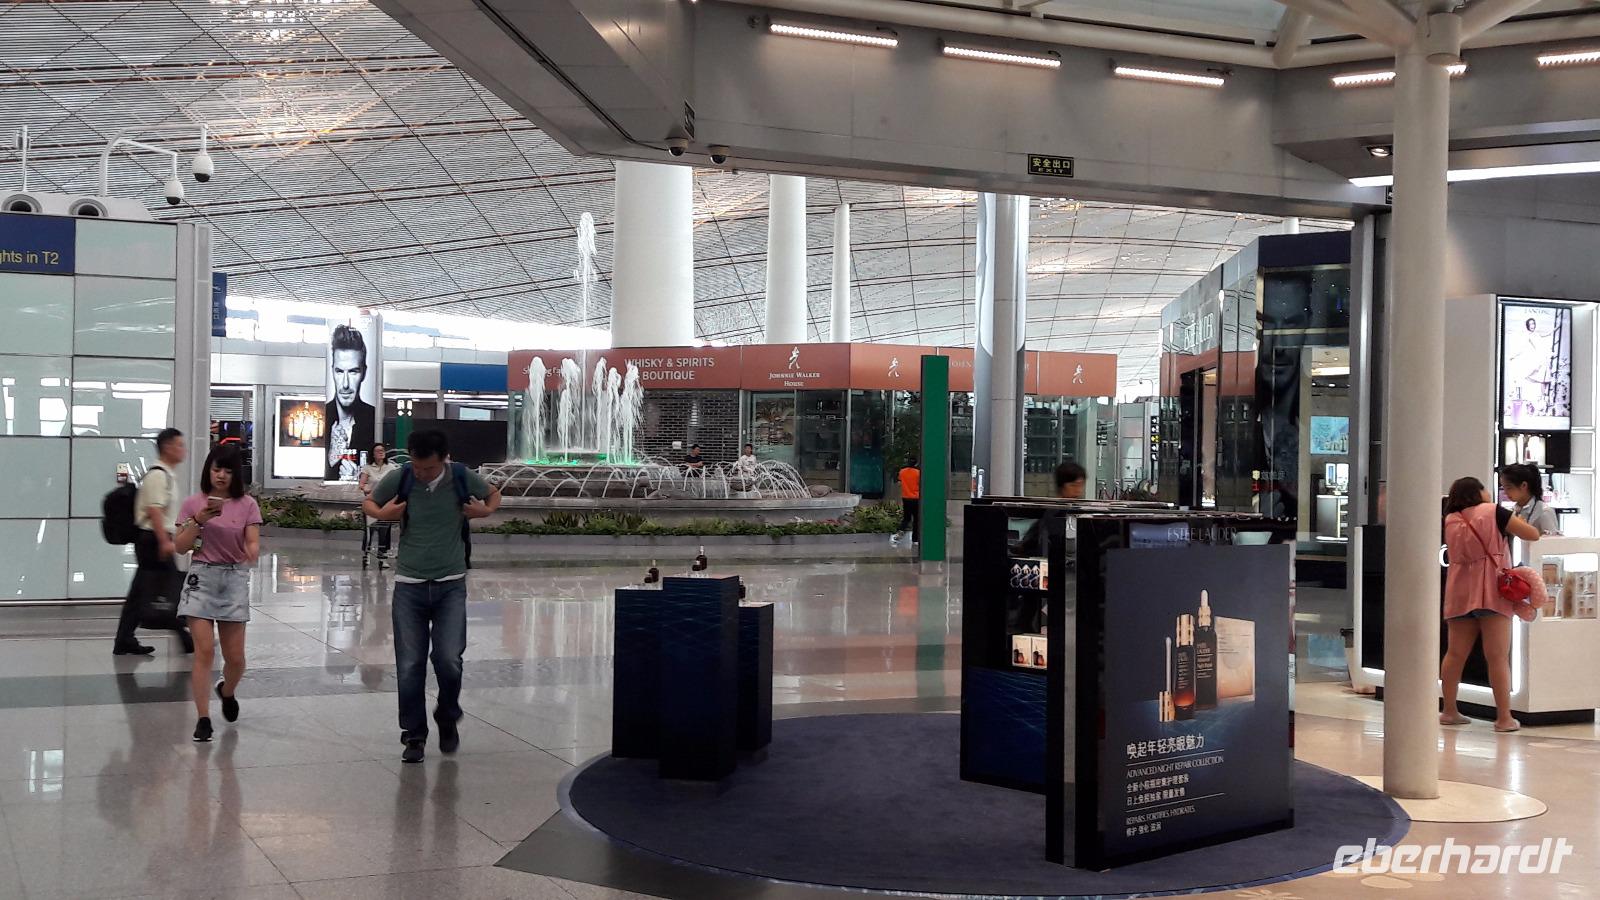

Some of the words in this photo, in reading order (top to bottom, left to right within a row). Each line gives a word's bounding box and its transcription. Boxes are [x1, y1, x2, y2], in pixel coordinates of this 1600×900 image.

[1032, 158, 1070, 168] 安全出口
[26, 250, 39, 264] in
[42, 251, 59, 265] T2
[666, 358, 673, 368] &
[676, 357, 715, 367] SPIRITS
[642, 370, 696, 380] BOUTIQUE
[1127, 733, 1204, 759] 唤起年轻亮眼魅力
[1126, 765, 1157, 778] ADVANCED
[1158, 763, 1174, 773] NIGHT
[1174, 760, 1192, 770] REPAIR
[1192, 755, 1224, 768] COLLECTION
